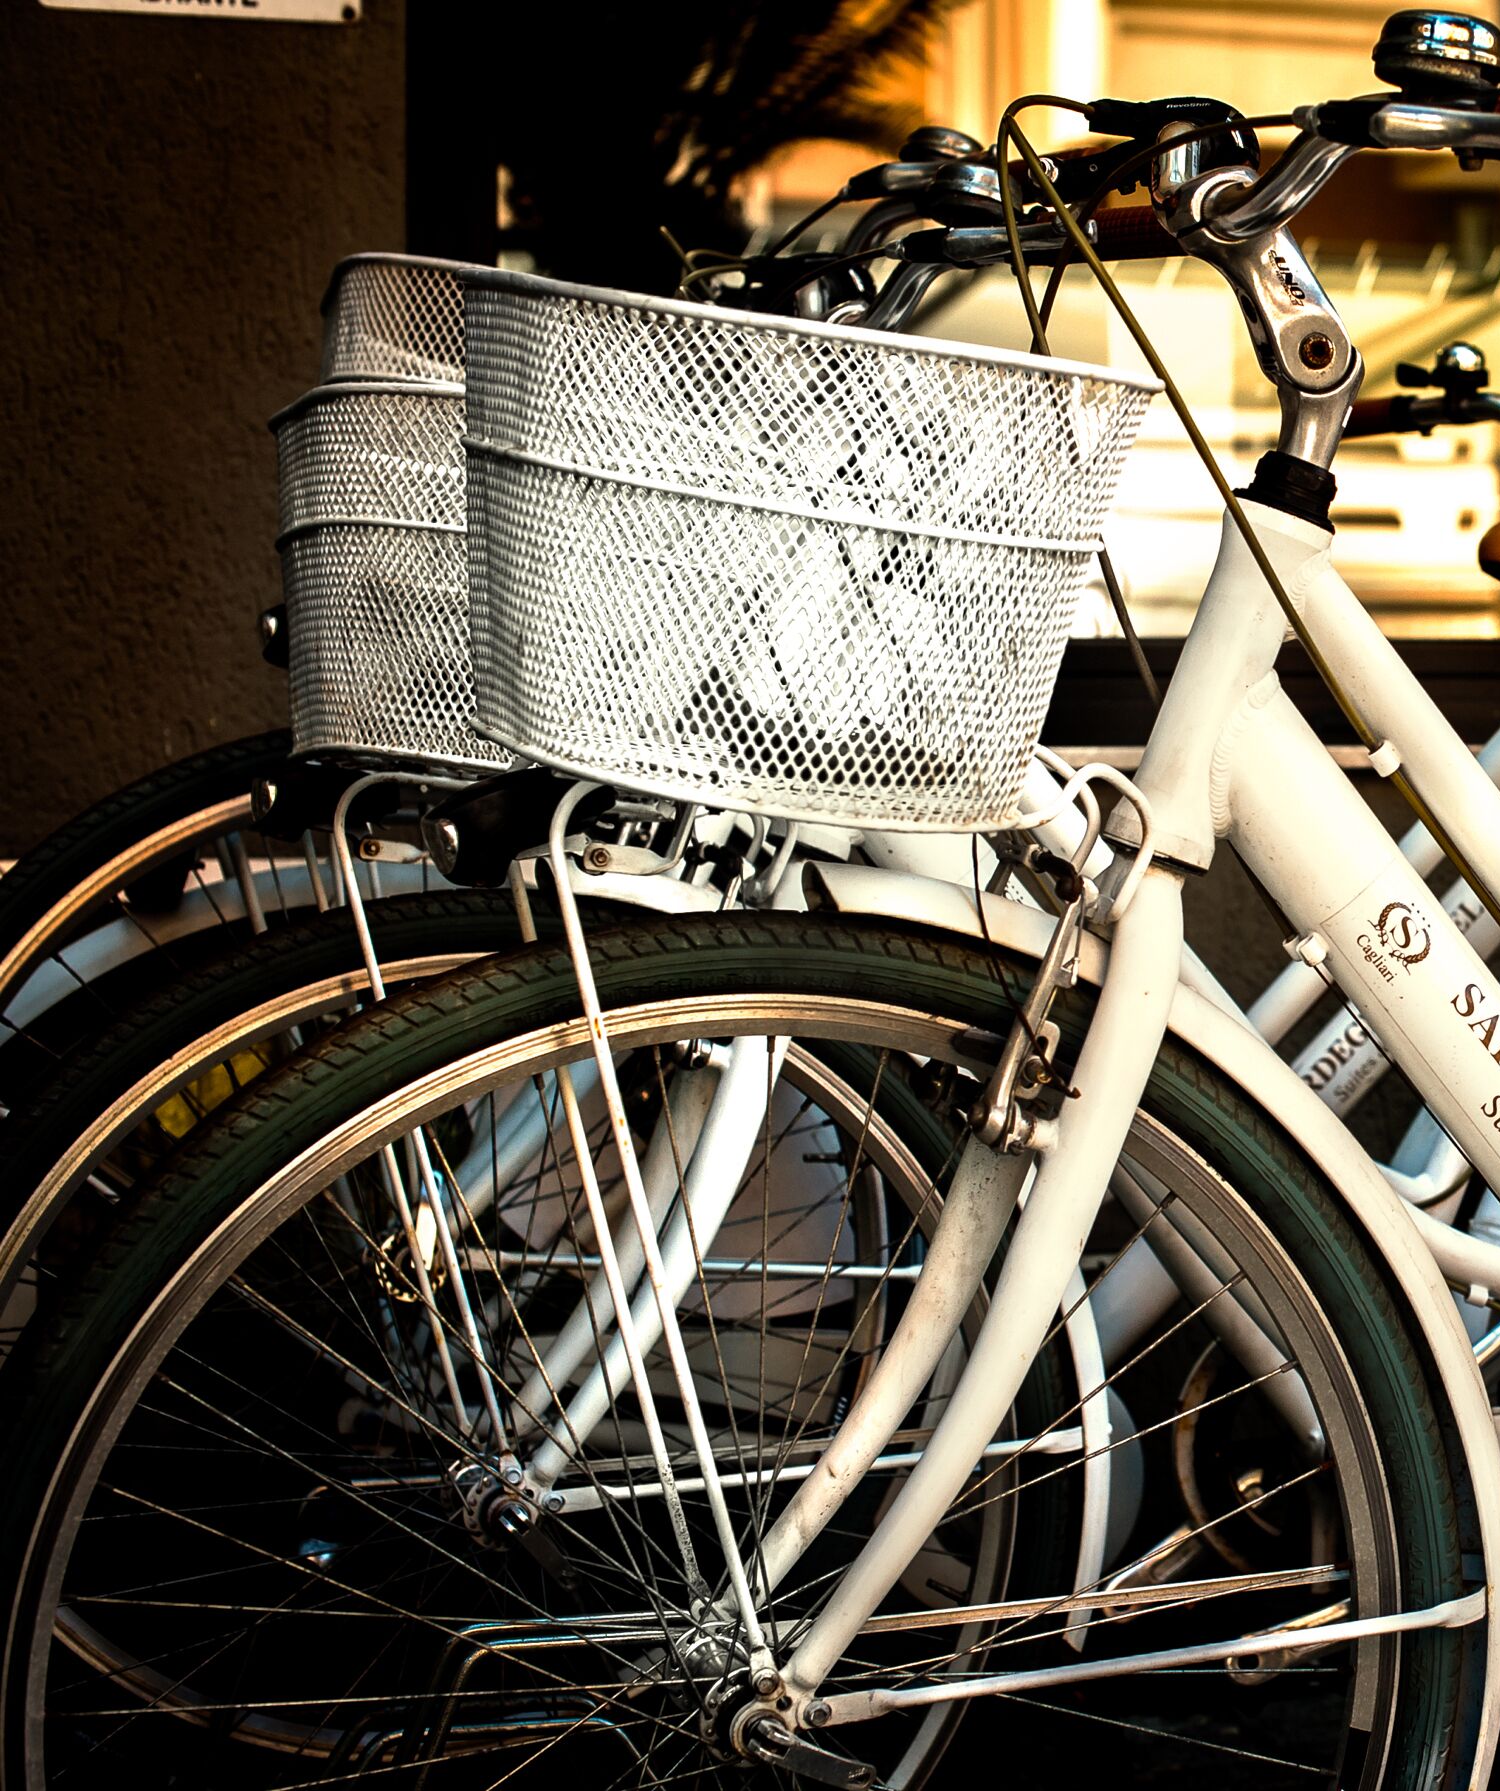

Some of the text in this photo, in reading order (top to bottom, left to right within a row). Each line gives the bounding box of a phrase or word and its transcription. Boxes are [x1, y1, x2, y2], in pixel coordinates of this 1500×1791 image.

[1274, 256, 1306, 299] UNO
[1390, 916, 1419, 949] S
[1356, 933, 1398, 984] Cagliari
